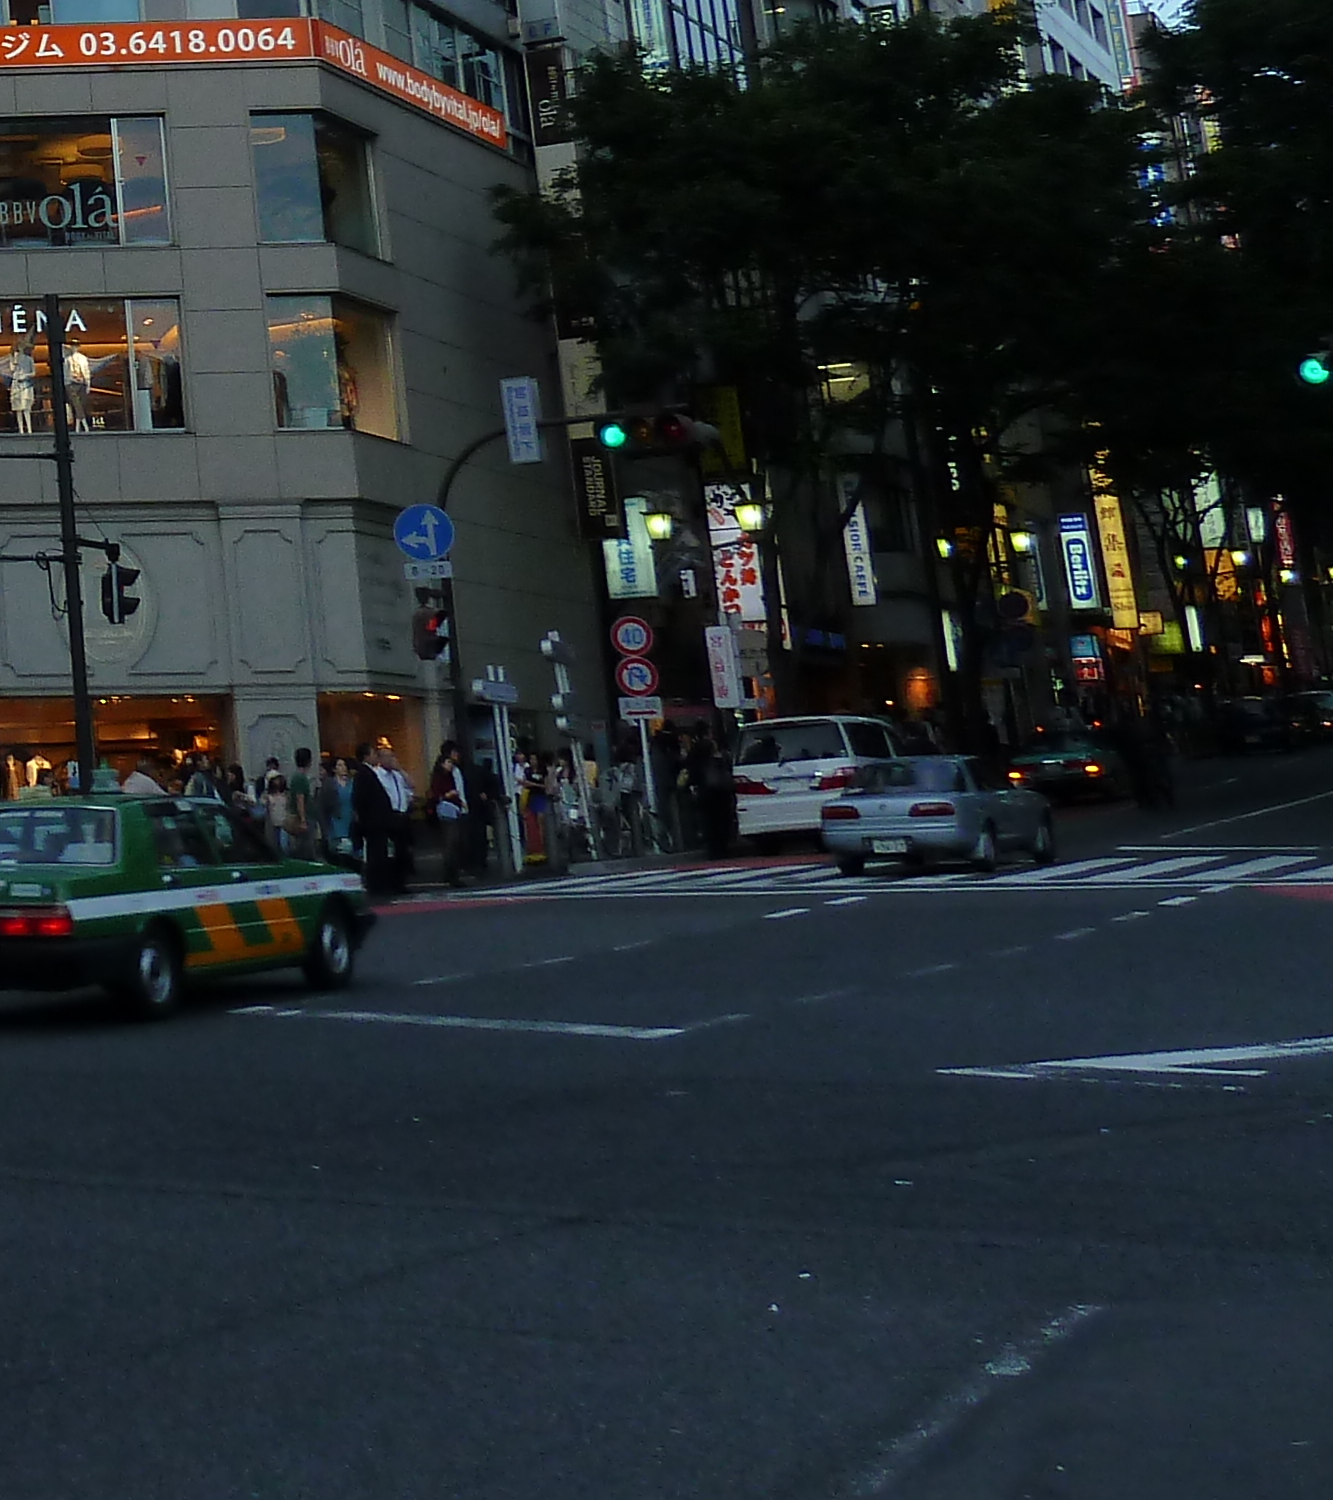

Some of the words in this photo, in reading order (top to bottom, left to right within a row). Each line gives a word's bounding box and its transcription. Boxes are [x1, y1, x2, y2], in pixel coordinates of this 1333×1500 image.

[79, 27, 296, 57] 03.6418.0064
[591, 455, 607, 516] JOURNAL
[1068, 542, 1089, 597] Berlitz
